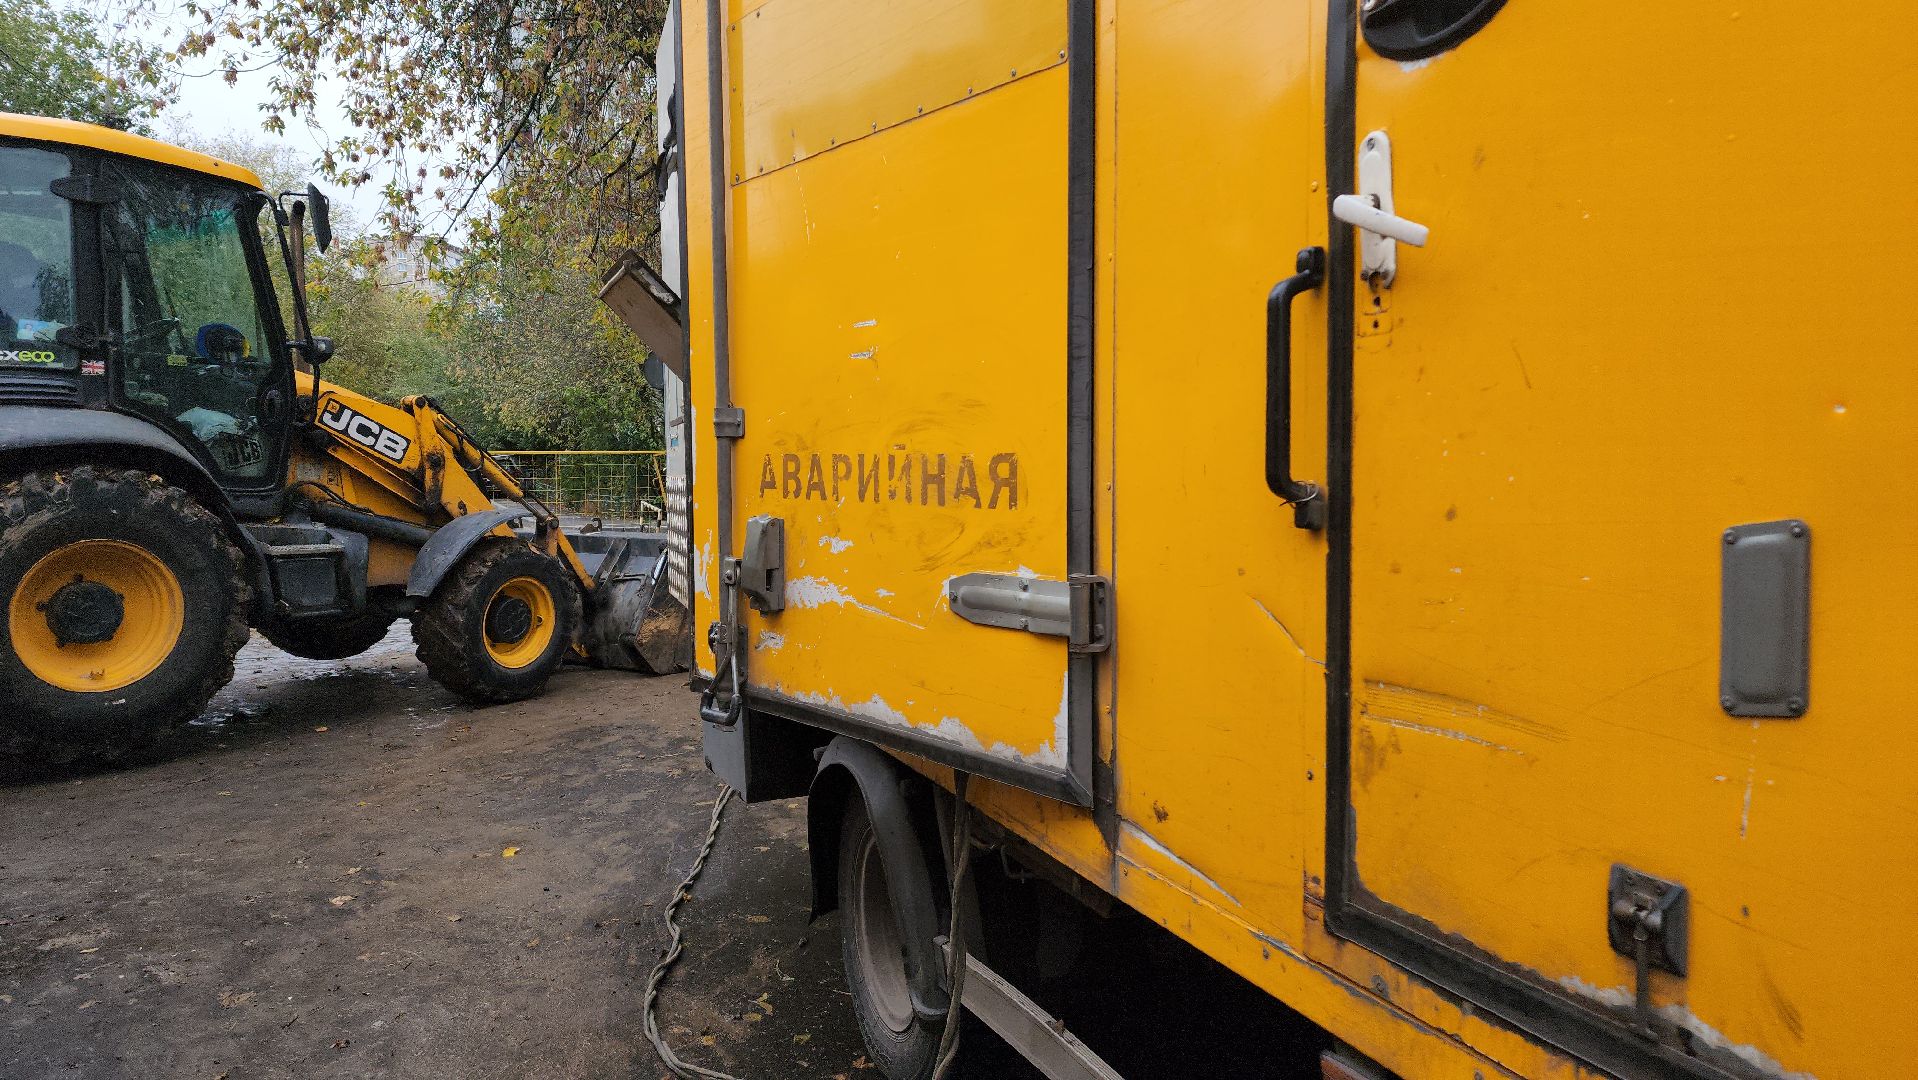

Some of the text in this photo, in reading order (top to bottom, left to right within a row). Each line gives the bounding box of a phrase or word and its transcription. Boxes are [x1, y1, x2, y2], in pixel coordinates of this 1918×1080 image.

[0, 350, 55, 363] xeco
[322, 408, 408, 460] JCB
[759, 444, 1018, 510] АВАРИЙНАЯ
